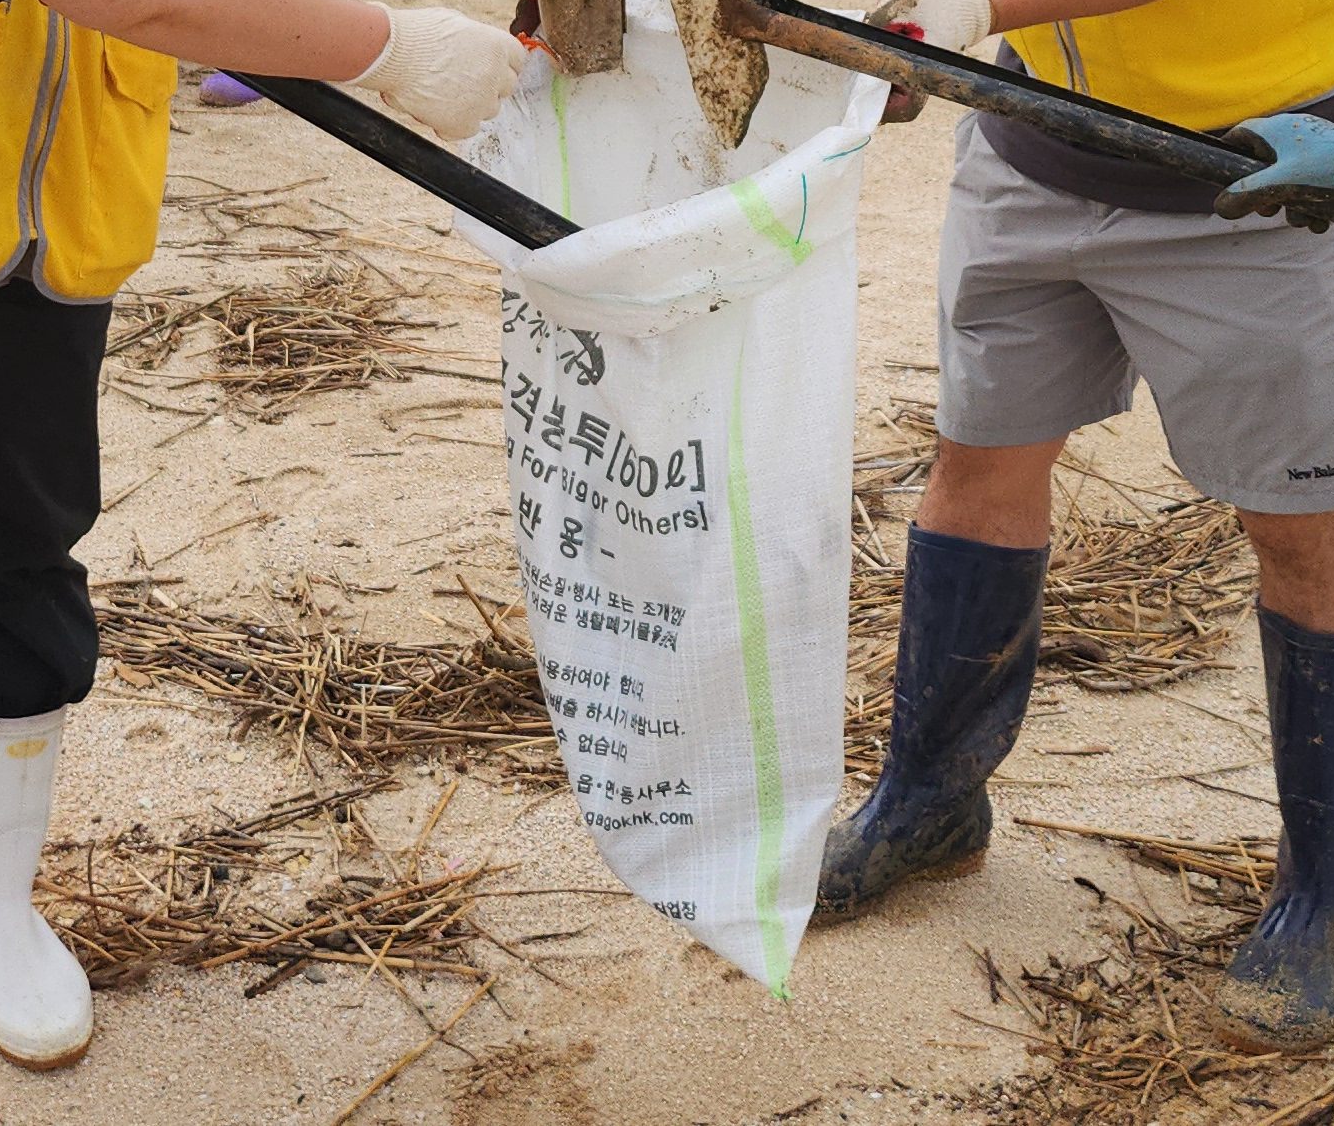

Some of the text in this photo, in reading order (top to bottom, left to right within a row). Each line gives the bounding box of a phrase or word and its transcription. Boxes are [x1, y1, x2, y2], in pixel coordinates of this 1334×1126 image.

[521, 444, 559, 484] For
[591, 489, 609, 514] or
[615, 499, 709, 536] Others]
[1287, 468, 1312, 481] New
